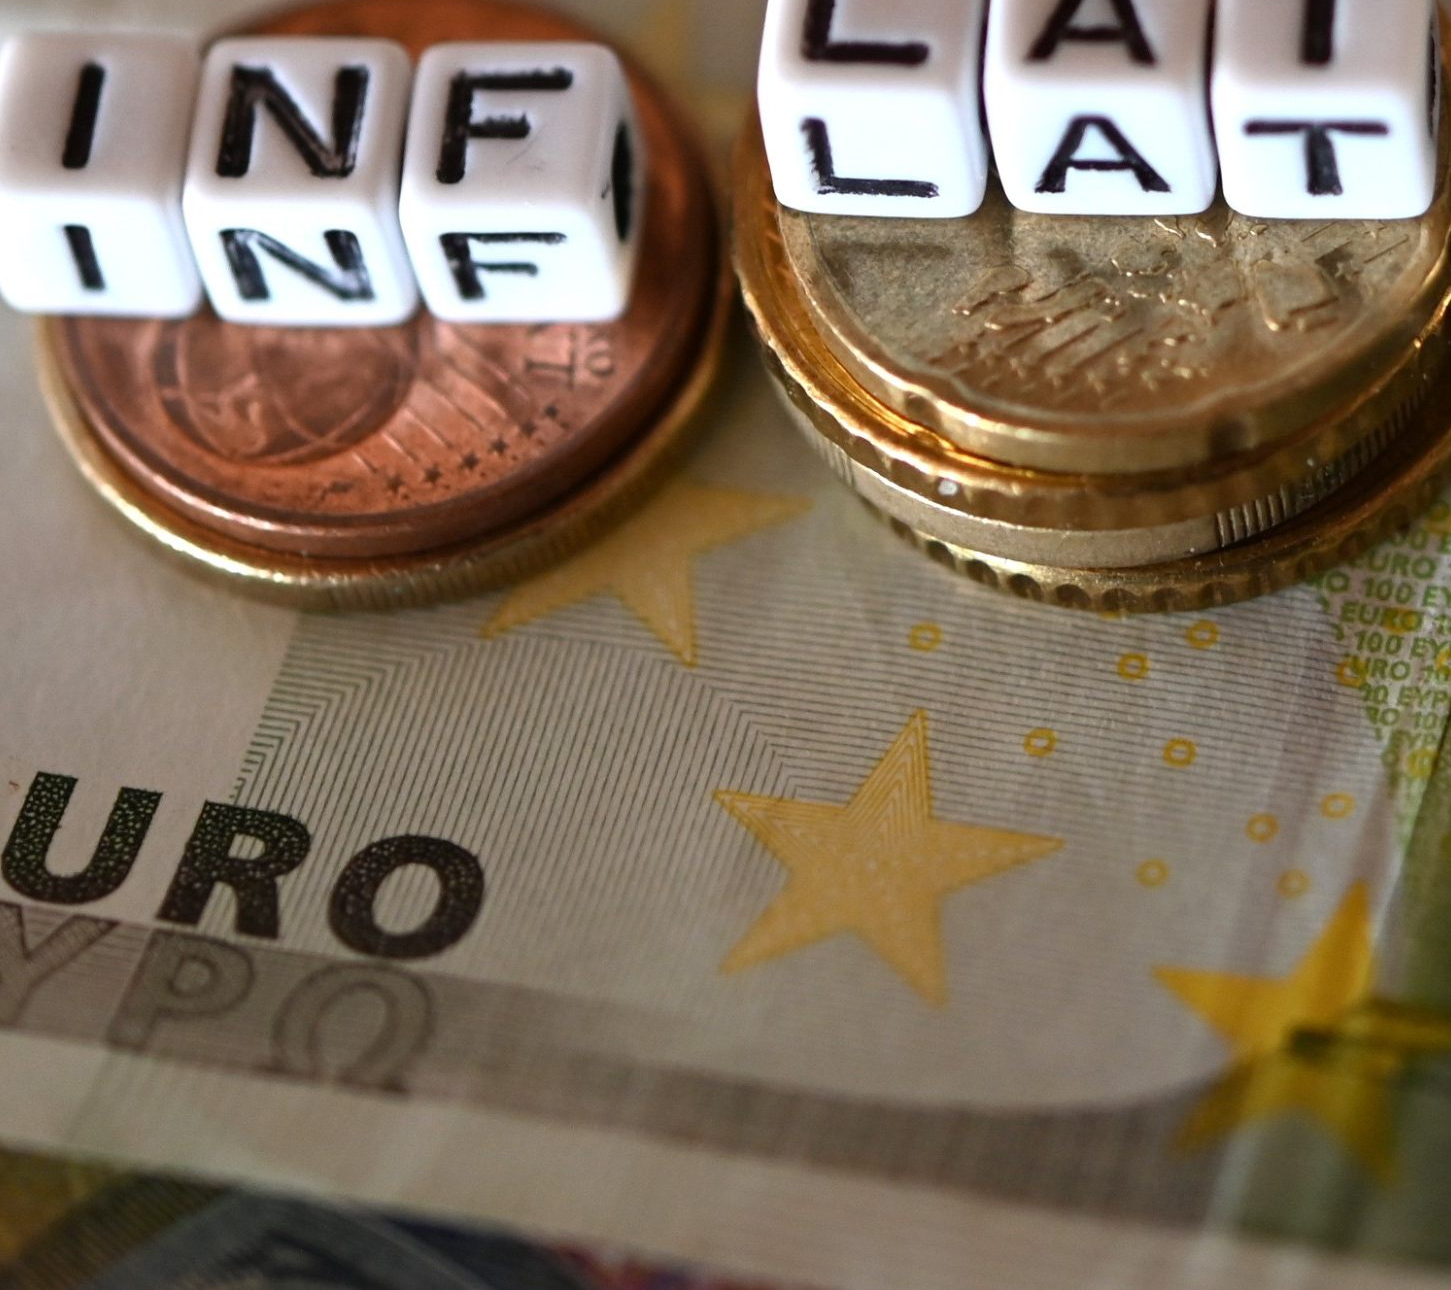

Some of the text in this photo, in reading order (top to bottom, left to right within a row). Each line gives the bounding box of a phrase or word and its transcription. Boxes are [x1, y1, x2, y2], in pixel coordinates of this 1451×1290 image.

[61, 61, 574, 186] INF
[799, 115, 1391, 199] LAT
[62, 224, 569, 302] INF
[1341, 600, 1424, 633] EURO
[1362, 576, 1416, 606] 100
[1355, 630, 1404, 656] 100
[1, 770, 487, 962] URO
